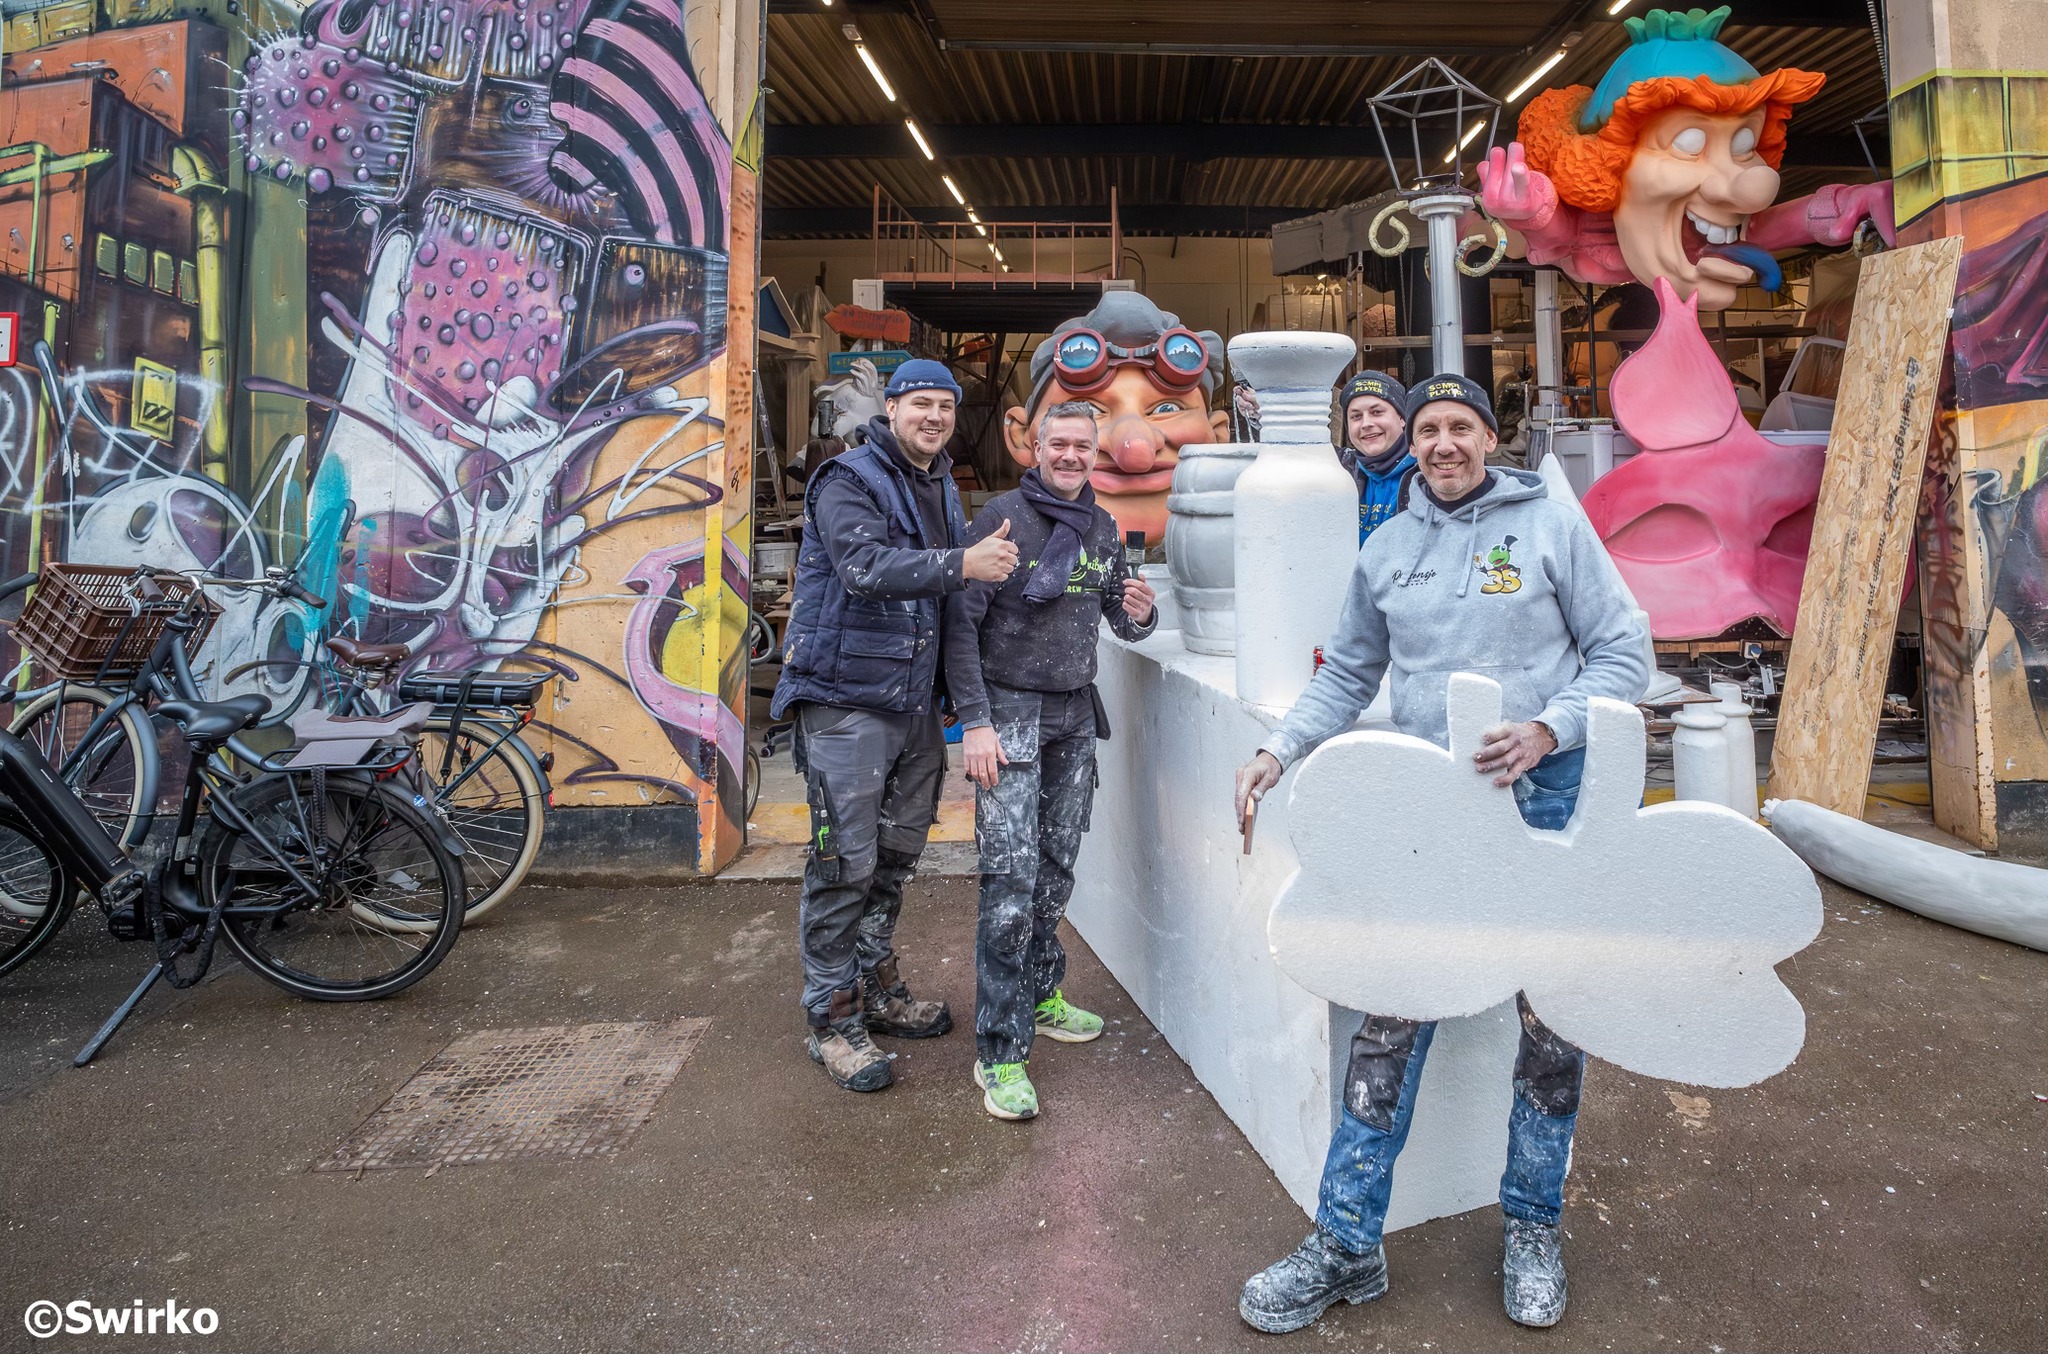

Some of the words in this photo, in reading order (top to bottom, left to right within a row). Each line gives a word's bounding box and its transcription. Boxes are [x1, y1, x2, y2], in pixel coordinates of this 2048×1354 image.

[1429, 389, 1463, 397] PLAYR
[1884, 482, 1899, 521] Zero
[1087, 557, 1107, 572] vibes
[1064, 585, 1082, 593] REW
[1480, 569, 1522, 594] 35
